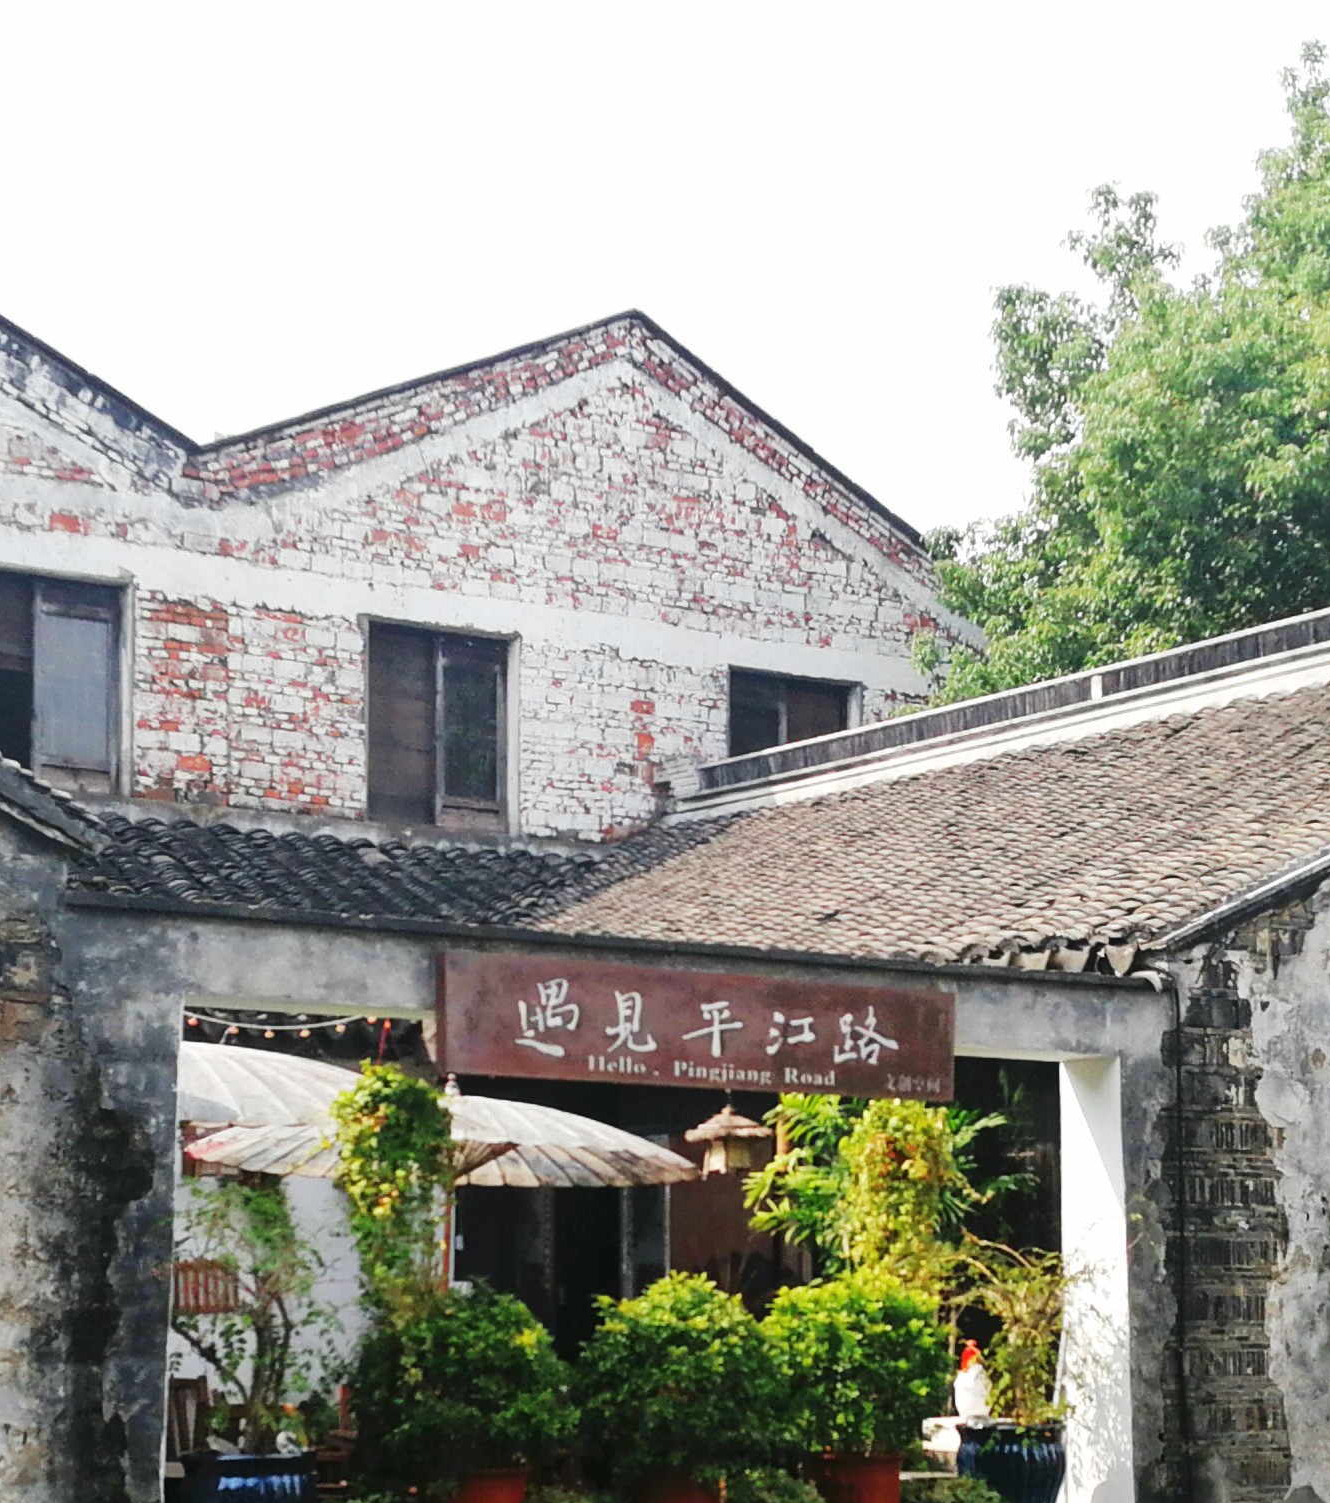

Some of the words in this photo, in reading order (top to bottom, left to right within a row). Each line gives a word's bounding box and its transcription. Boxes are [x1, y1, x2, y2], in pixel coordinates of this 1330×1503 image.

[515, 977, 899, 1065] 遇见平江路
[673, 1060, 772, 1086] Pingjiang
[783, 1069, 836, 1088] Road
